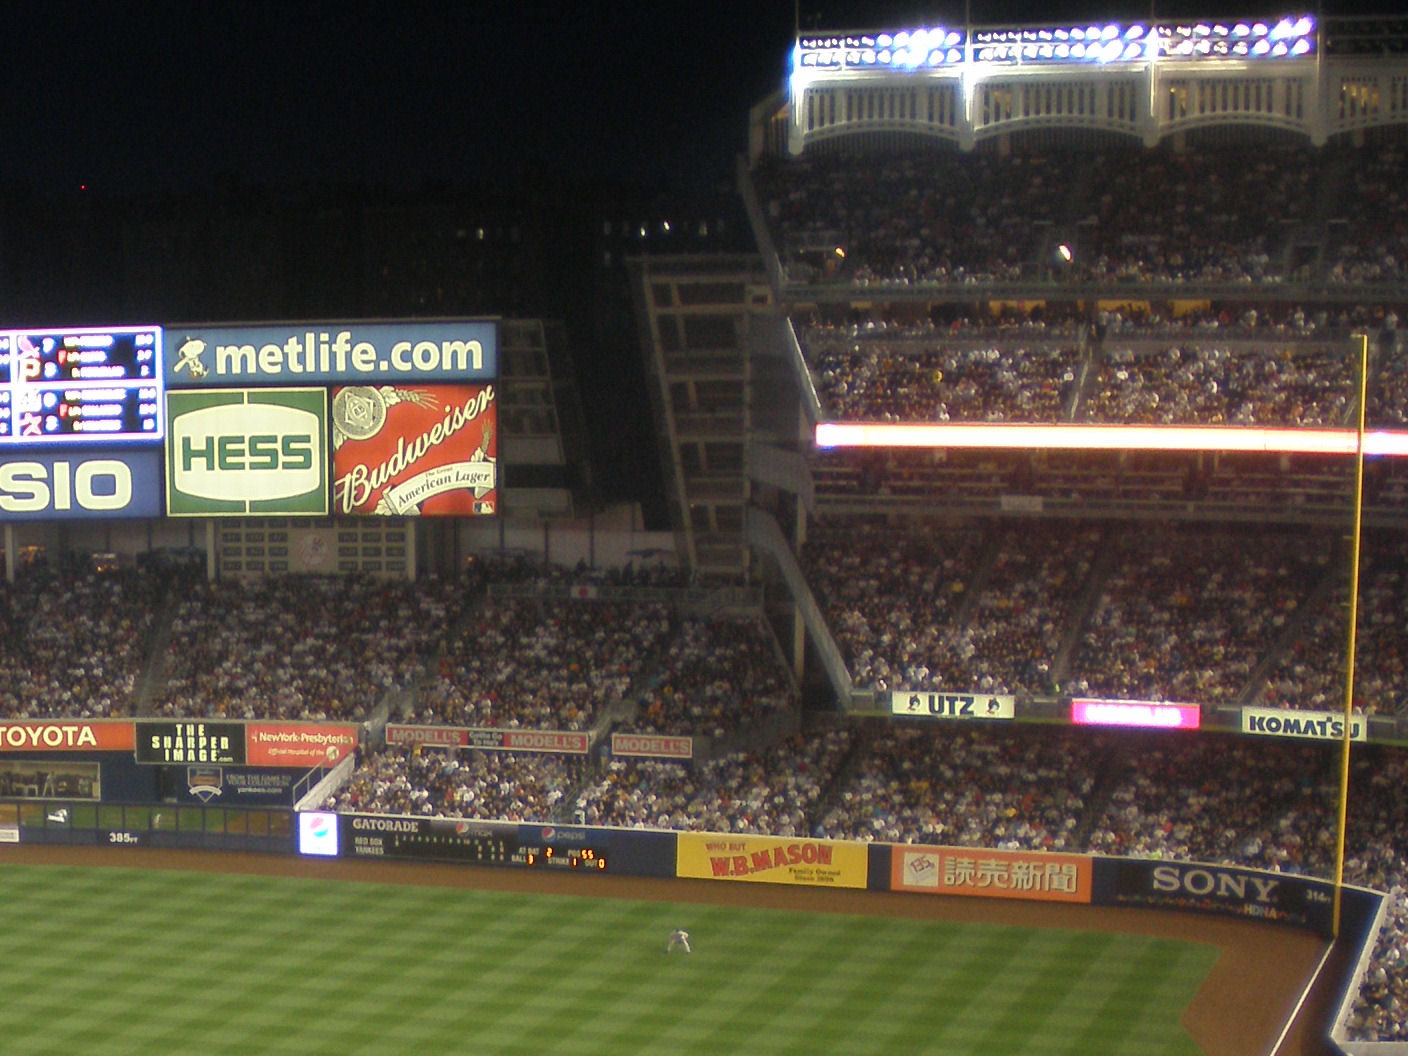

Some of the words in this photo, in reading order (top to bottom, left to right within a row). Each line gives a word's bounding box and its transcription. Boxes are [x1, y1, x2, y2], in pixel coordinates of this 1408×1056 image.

[215, 331, 484, 375] metlife.com
[181, 434, 313, 471] HESS
[333, 384, 496, 513] Budweiser
[396, 471, 452, 508] American
[454, 469, 492, 491] Lager
[928, 695, 975, 715] UTZ
[175, 724, 205, 736] THE
[1248, 713, 1360, 738] KOMATSU
[152, 735, 229, 750] SHARPER
[392, 729, 461, 743] MODELL'S
[510, 734, 582, 748] MODELL'S
[614, 738, 690, 754] MODELL'S
[352, 818, 419, 833] GATORADE
[705, 842, 727, 852] WHO
[729, 842, 747, 852] BUT
[944, 856, 1078, 893] 読売新聞
[1152, 866, 1279, 902] SONY
